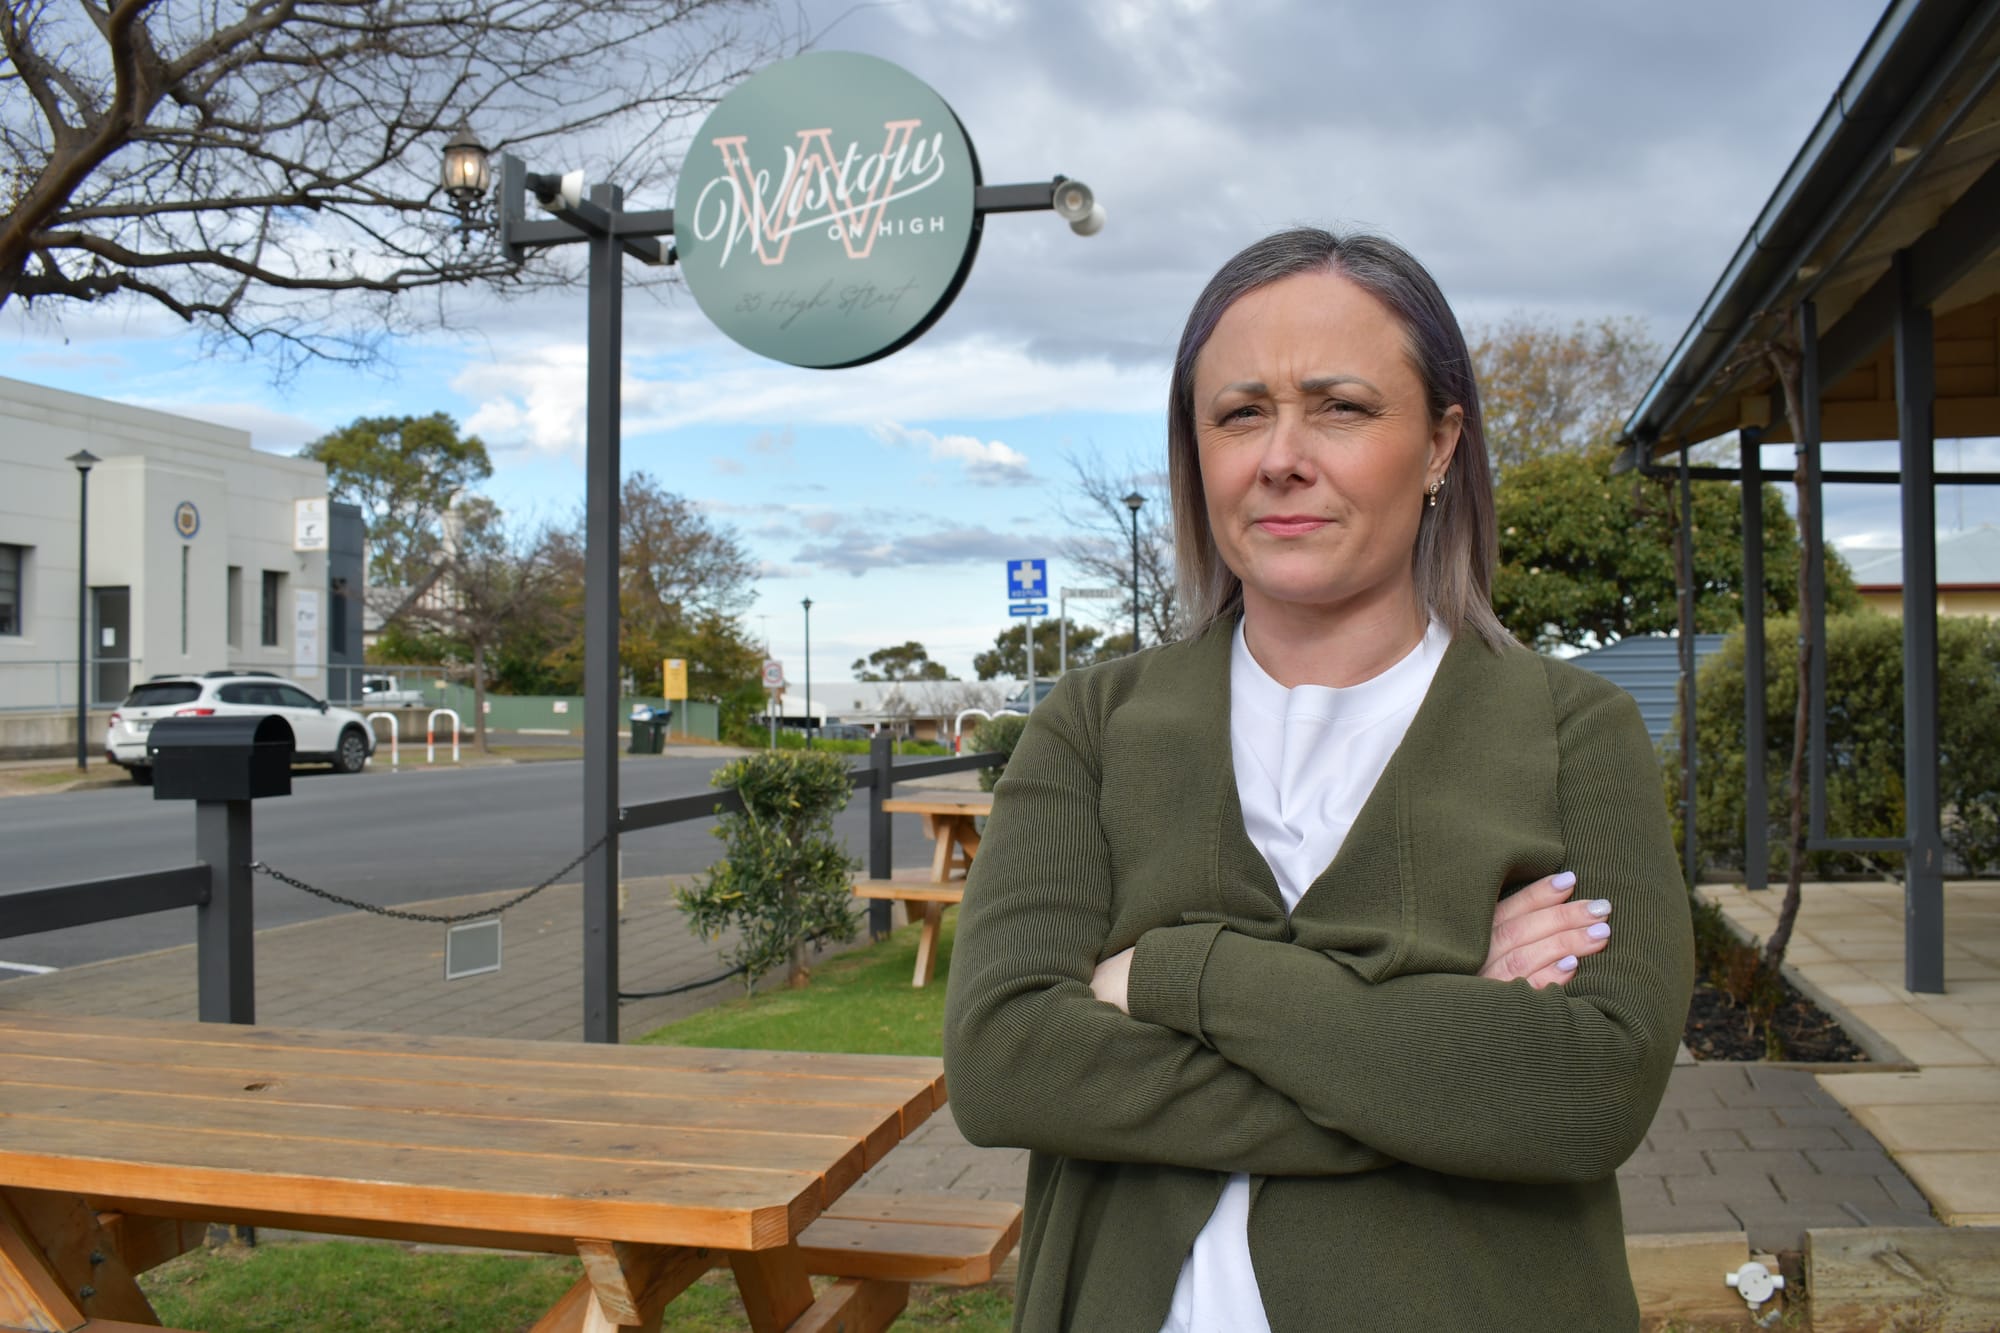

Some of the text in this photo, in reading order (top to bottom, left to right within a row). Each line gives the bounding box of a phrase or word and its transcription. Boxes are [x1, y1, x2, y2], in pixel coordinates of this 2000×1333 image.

[693, 132, 945, 268] Wistow
[828, 216, 945, 241] ON HIGH
